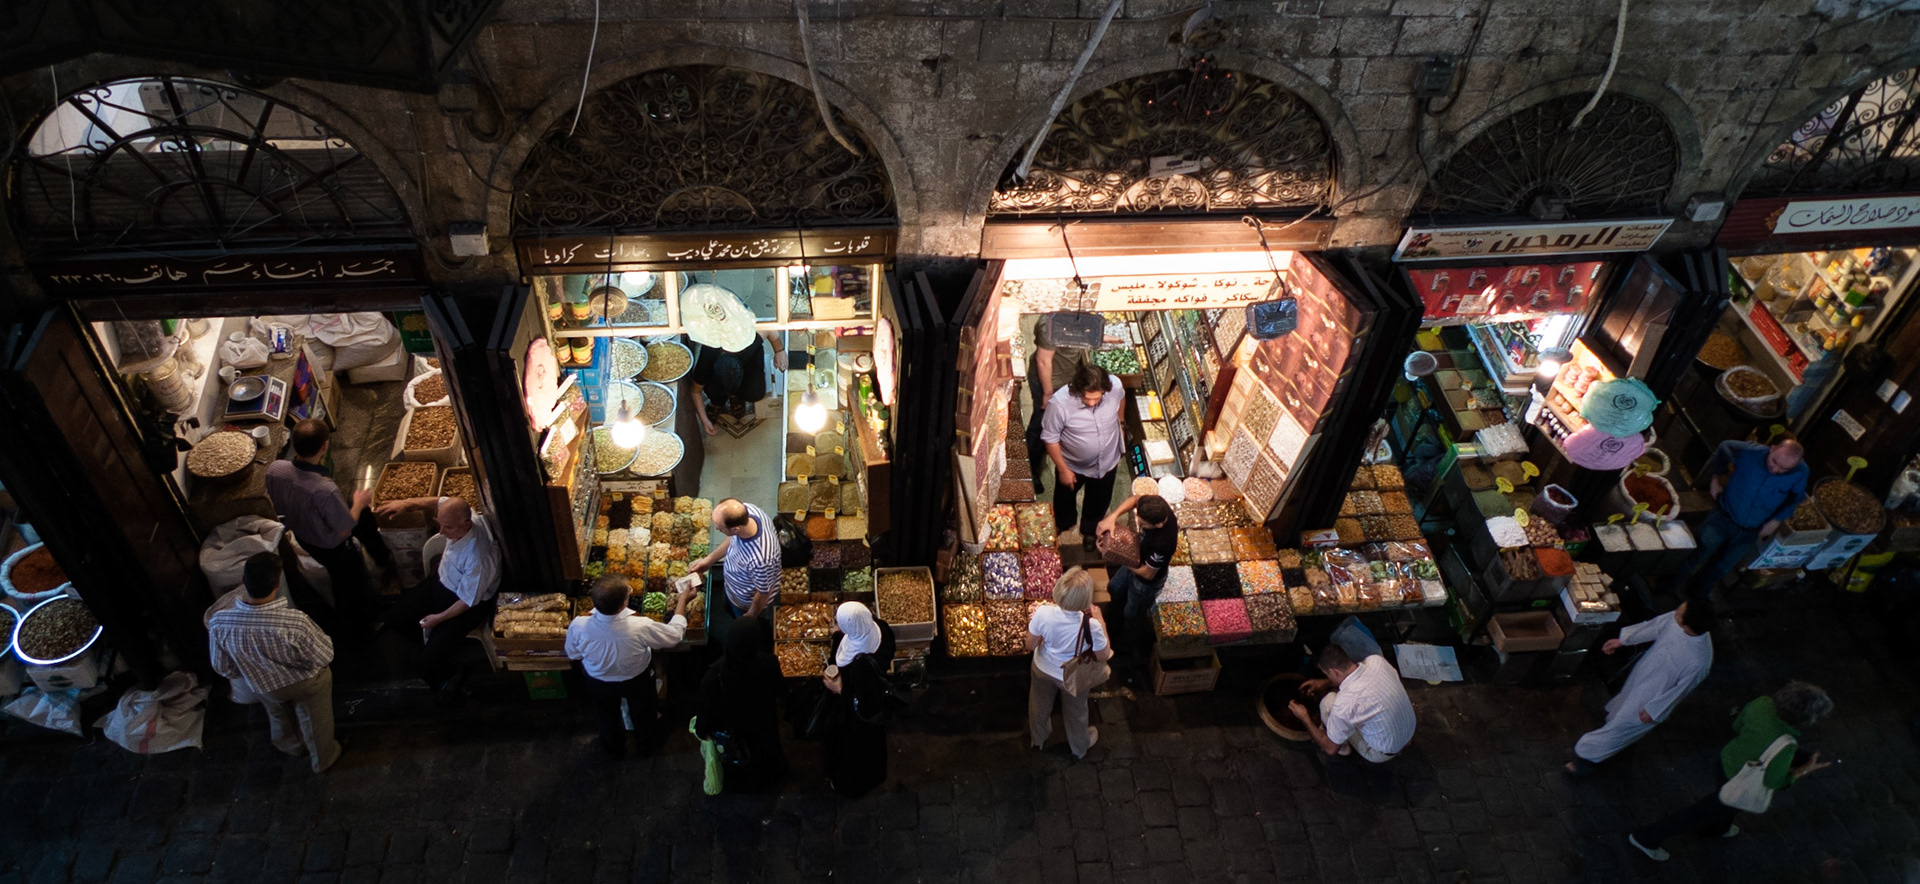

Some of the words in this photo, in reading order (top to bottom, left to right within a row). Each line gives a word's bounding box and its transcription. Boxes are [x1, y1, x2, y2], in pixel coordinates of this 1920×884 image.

[594, 243, 651, 259] بهارات
[667, 245, 700, 261] ديب
[700, 239, 718, 261] علي
[716, 243, 732, 259] محمد
[730, 243, 749, 258] بن
[749, 239, 778, 257] توفيق
[777, 240, 795, 255] محمد
[824, 236, 871, 254] قلوبات
[123, 264, 188, 284] هاتف
[1157, 277, 1198, 290] شوكولا
[1222, 293, 1259, 305] سكاكر
